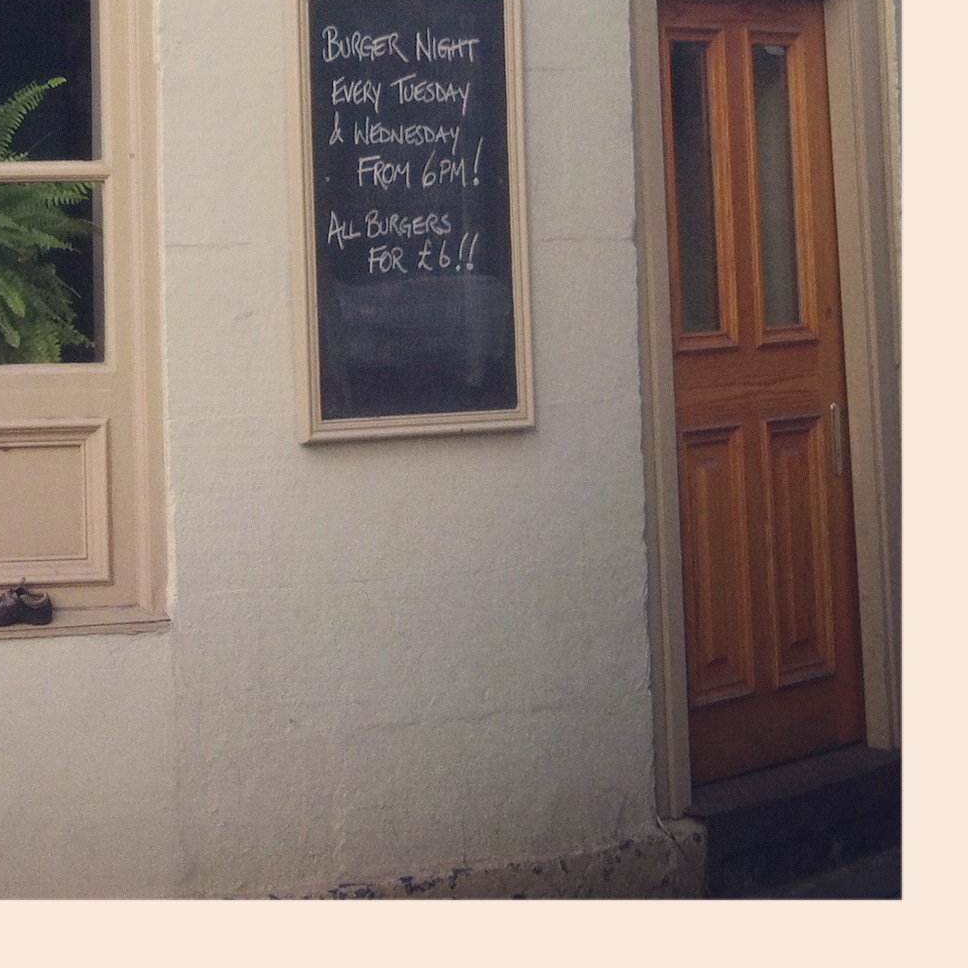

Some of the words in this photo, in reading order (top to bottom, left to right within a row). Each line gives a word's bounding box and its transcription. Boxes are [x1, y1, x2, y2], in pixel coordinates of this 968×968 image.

[322, 25, 409, 62] BURGER
[416, 27, 480, 62] NIGHT
[331, 76, 381, 114] EVERY
[390, 72, 470, 116] TUESDAY
[354, 116, 460, 156] WEDNESDAY
[357, 154, 411, 191] FROM
[327, 210, 361, 251] ALL
[364, 209, 451, 238] BURGERS
[368, 244, 408, 274] FOR
